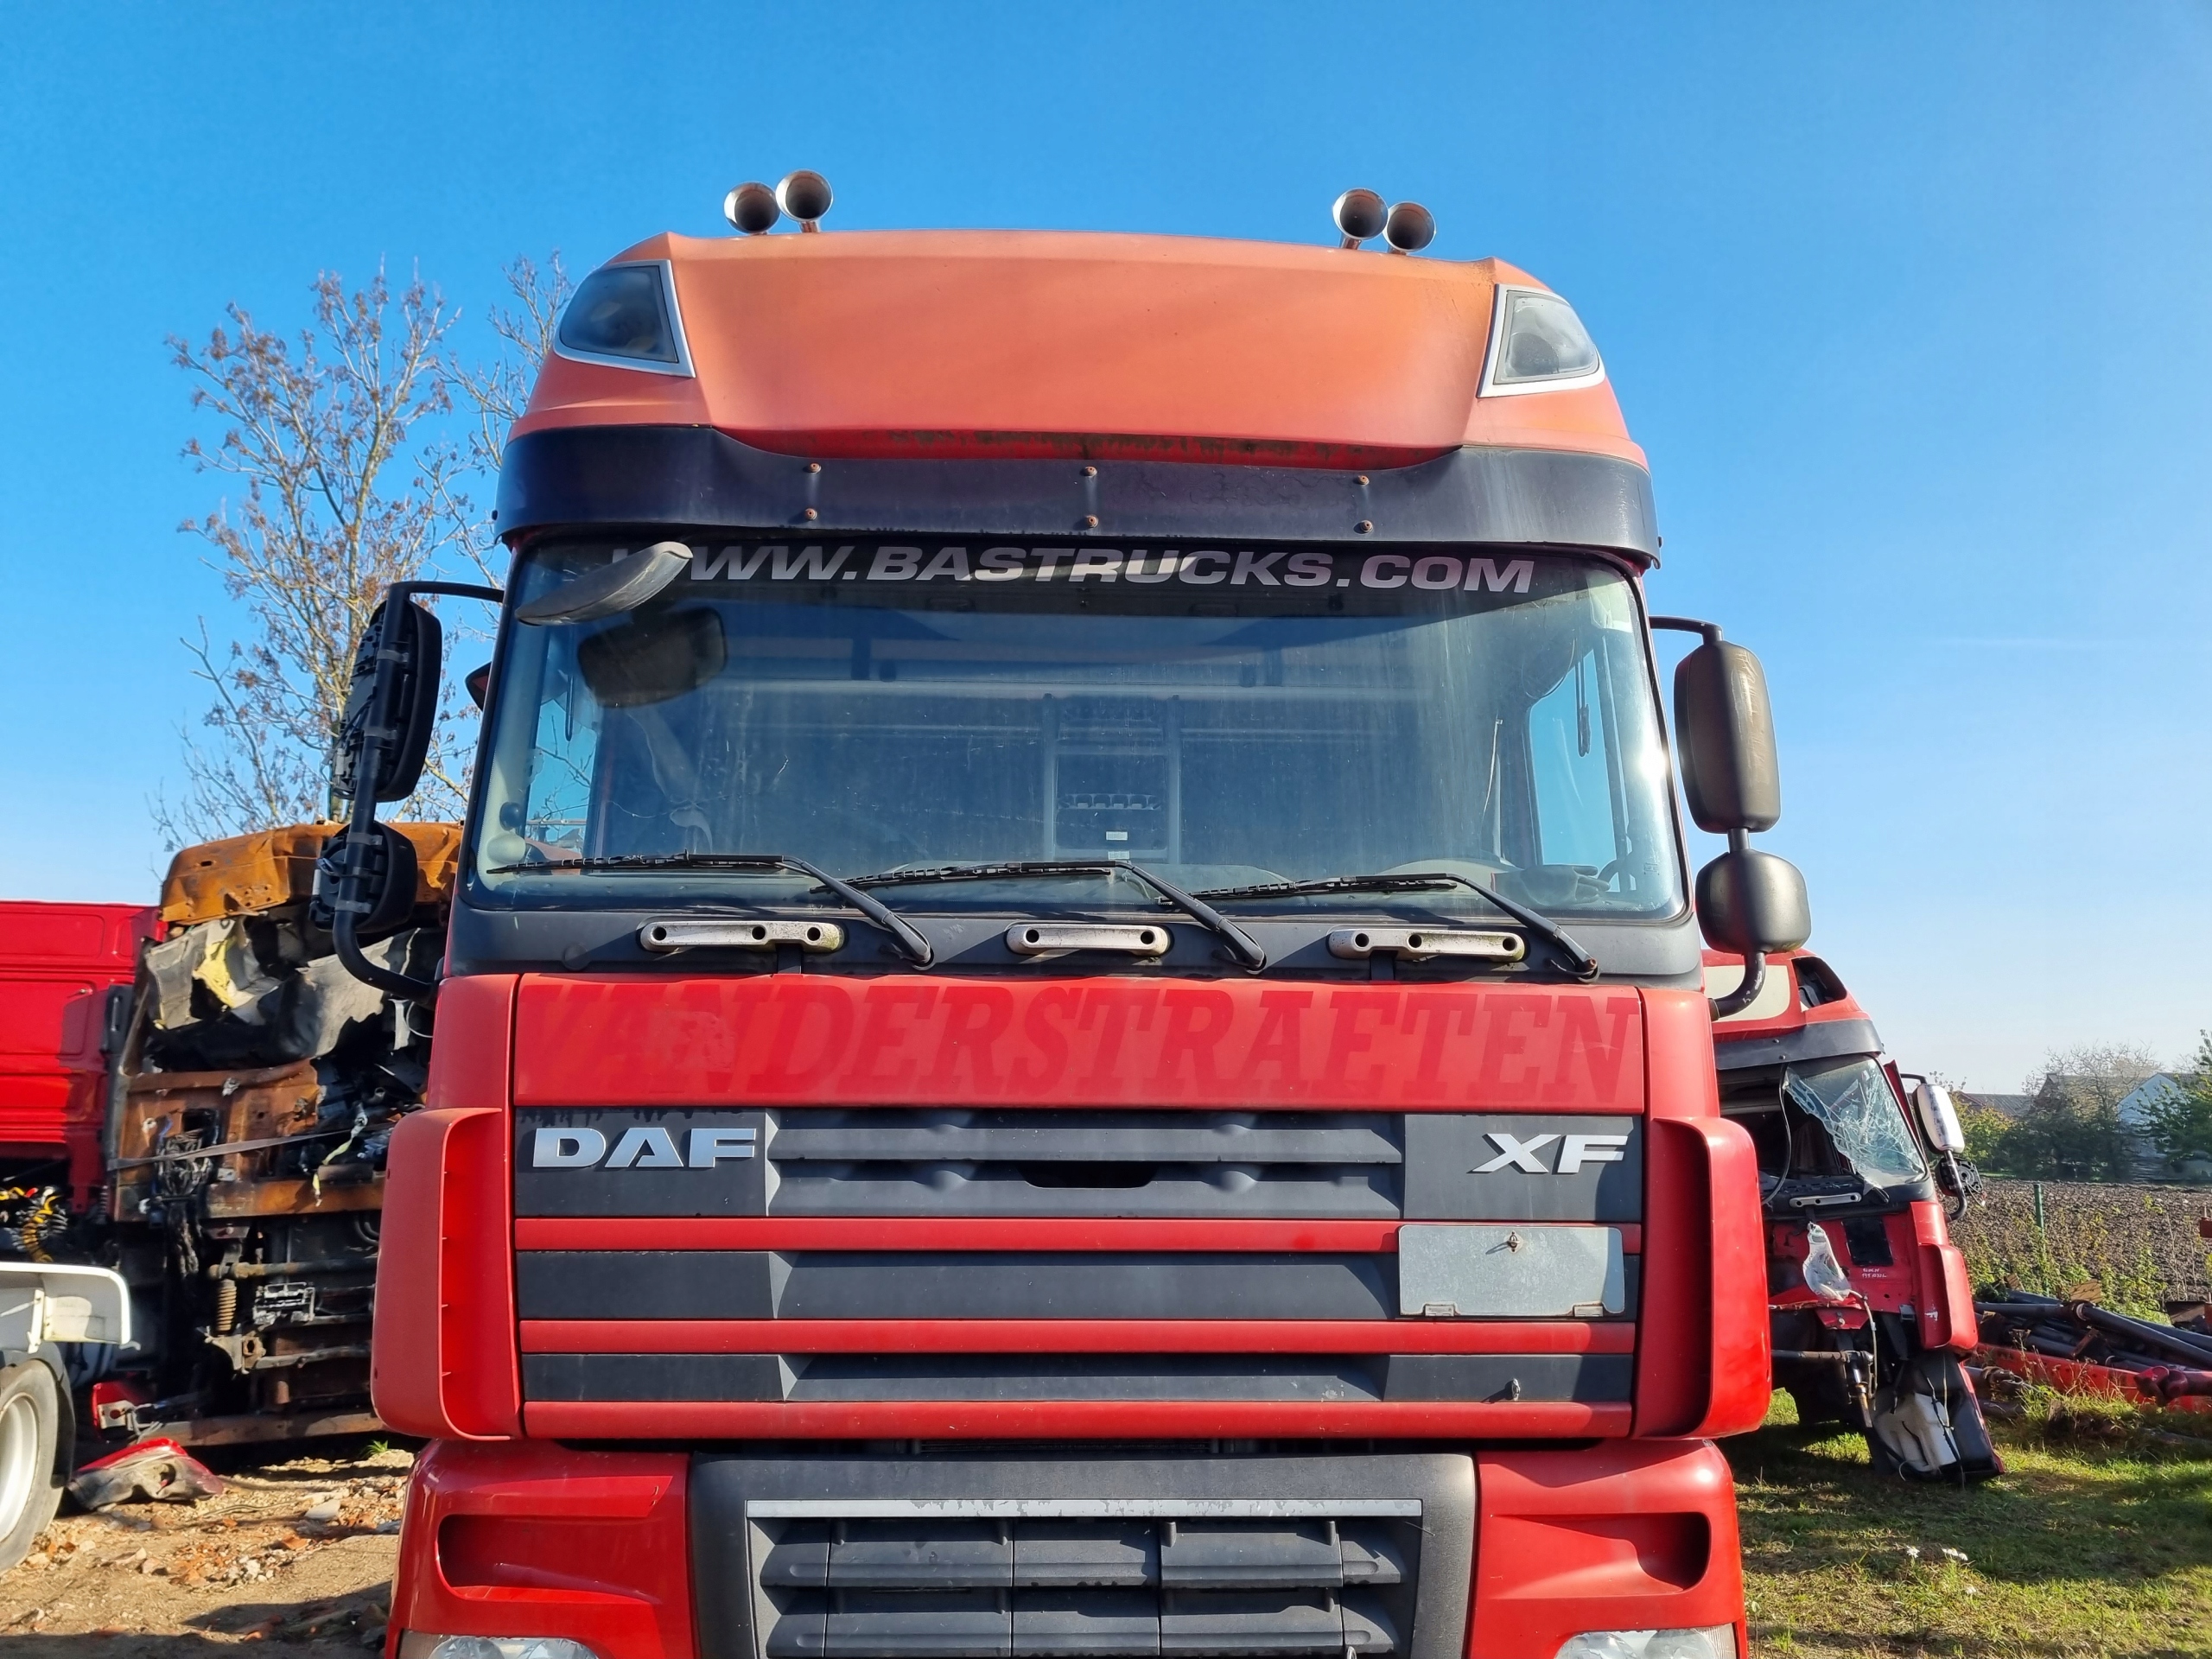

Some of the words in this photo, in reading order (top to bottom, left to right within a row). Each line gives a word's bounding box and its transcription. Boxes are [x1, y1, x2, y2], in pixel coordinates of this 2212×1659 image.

[612, 545, 1535, 593] WW.BASTRUCKS.COM
[520, 983, 1641, 1103] VANDERSTRAETEN
[532, 1127, 757, 1168] DAF
[1471, 1133, 1628, 1173] XF
